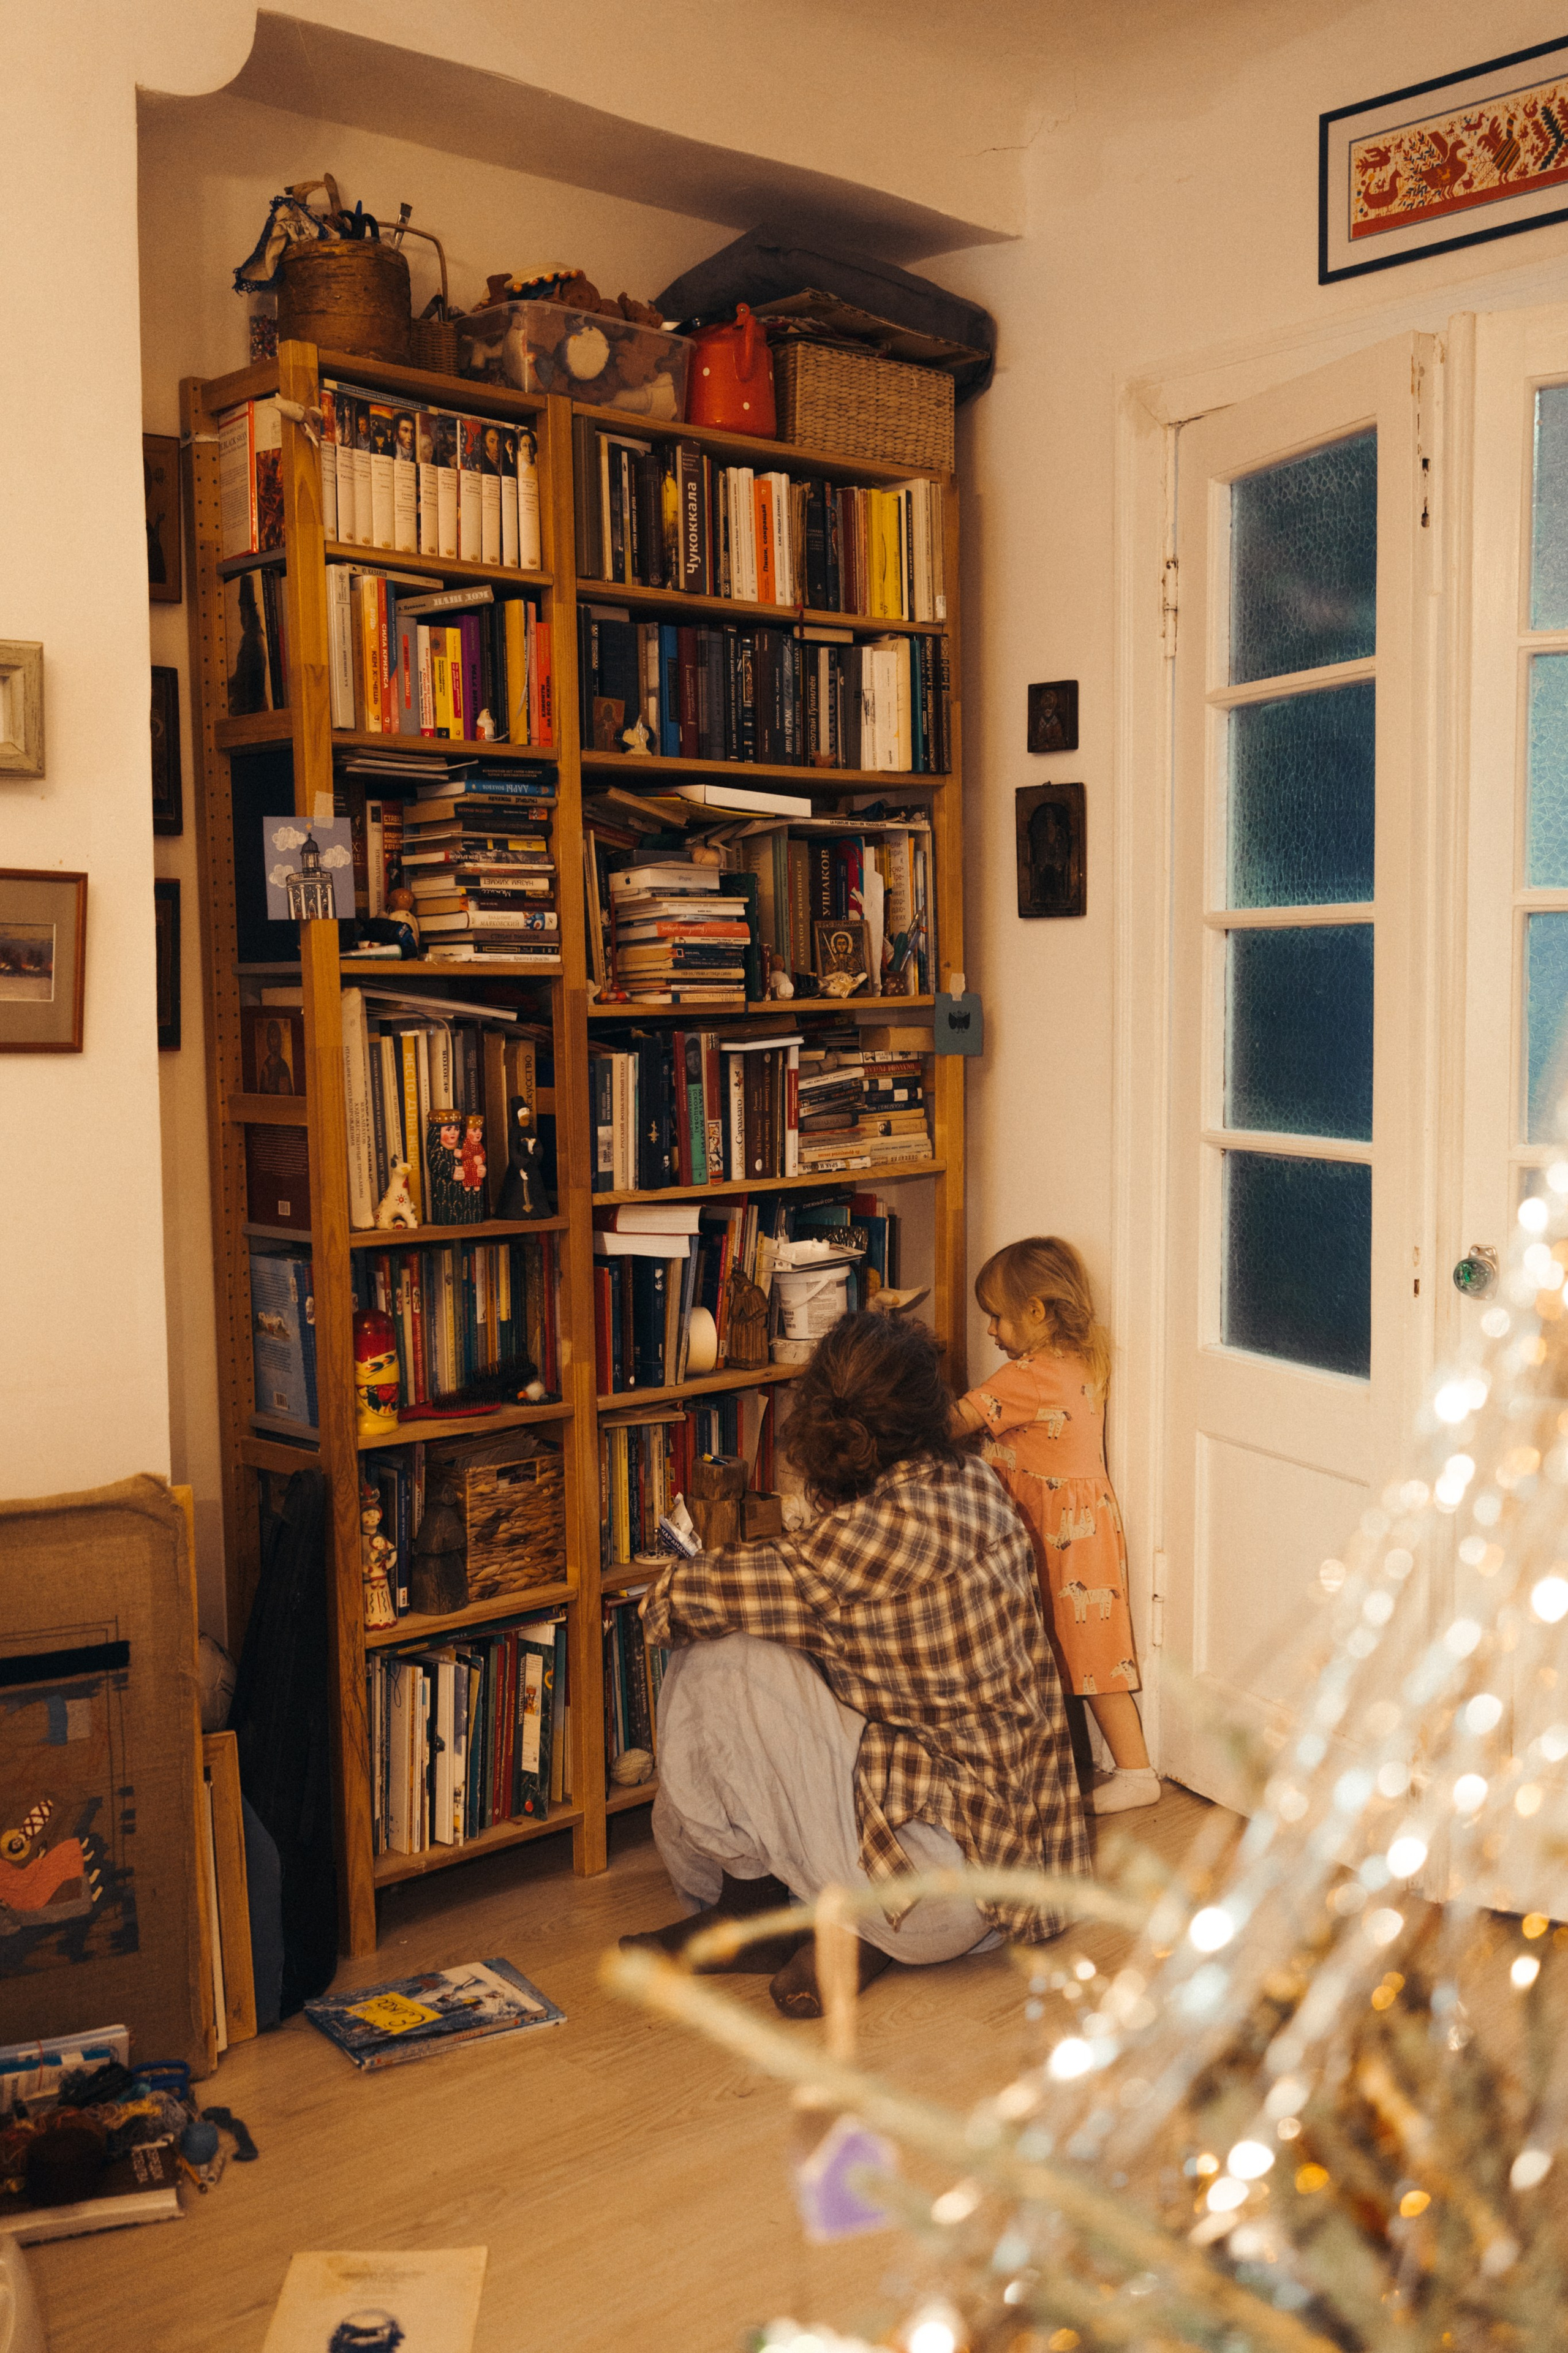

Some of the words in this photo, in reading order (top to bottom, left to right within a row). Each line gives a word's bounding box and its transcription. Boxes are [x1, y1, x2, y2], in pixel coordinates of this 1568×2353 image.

[687, 482, 701, 573] Чукоккала
[368, 568, 387, 578] КАЗАКОВ
[434, 594, 462, 606] НАШ
[465, 589, 489, 602] ДОМ
[506, 784, 529, 793] ДАРЫ
[821, 849, 831, 916] УШАКОВ
[345, 1046, 353, 1097] ИТАЛЬЯНСКОГО
[404, 1052, 415, 1092] МЕСТО
[354, 1103, 363, 1161] ХУДОЖЕСТВЕННЫЕ
[407, 1098, 418, 1130] ДЛЯ
[735, 1099, 745, 1144] Сарамаго
